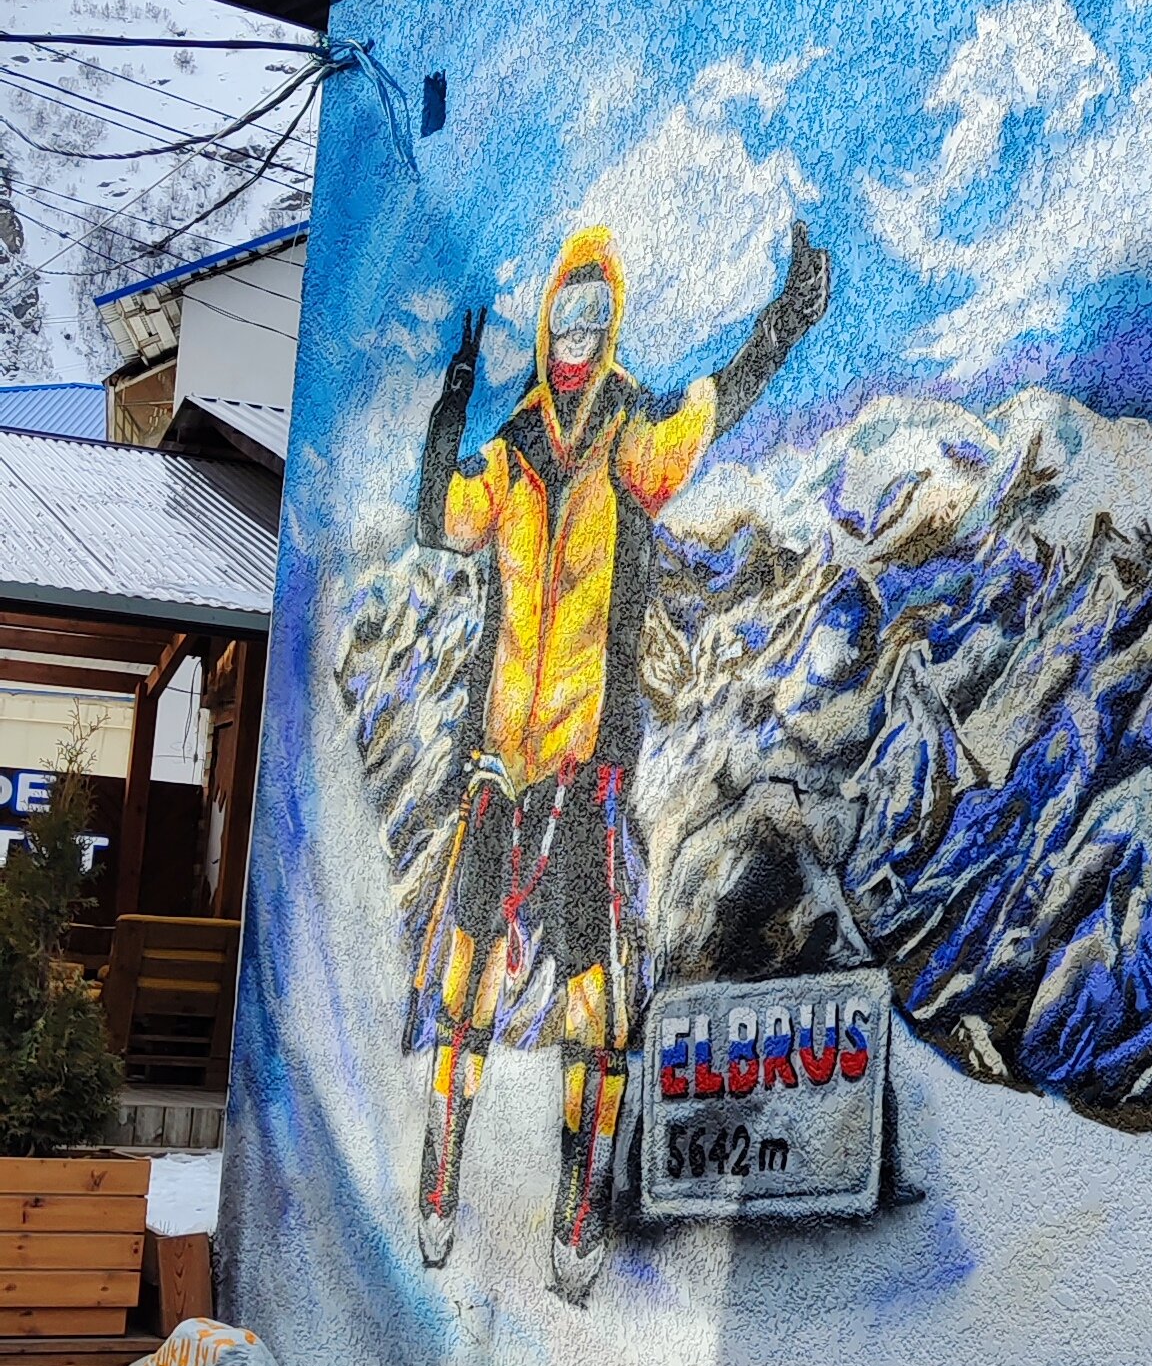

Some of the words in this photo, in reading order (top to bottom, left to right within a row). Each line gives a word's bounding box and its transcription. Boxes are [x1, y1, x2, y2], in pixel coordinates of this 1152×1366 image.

[660, 997, 869, 1098] ELBRUS
[667, 1125, 750, 1178] 5642
[758, 1137, 789, 1171] m
